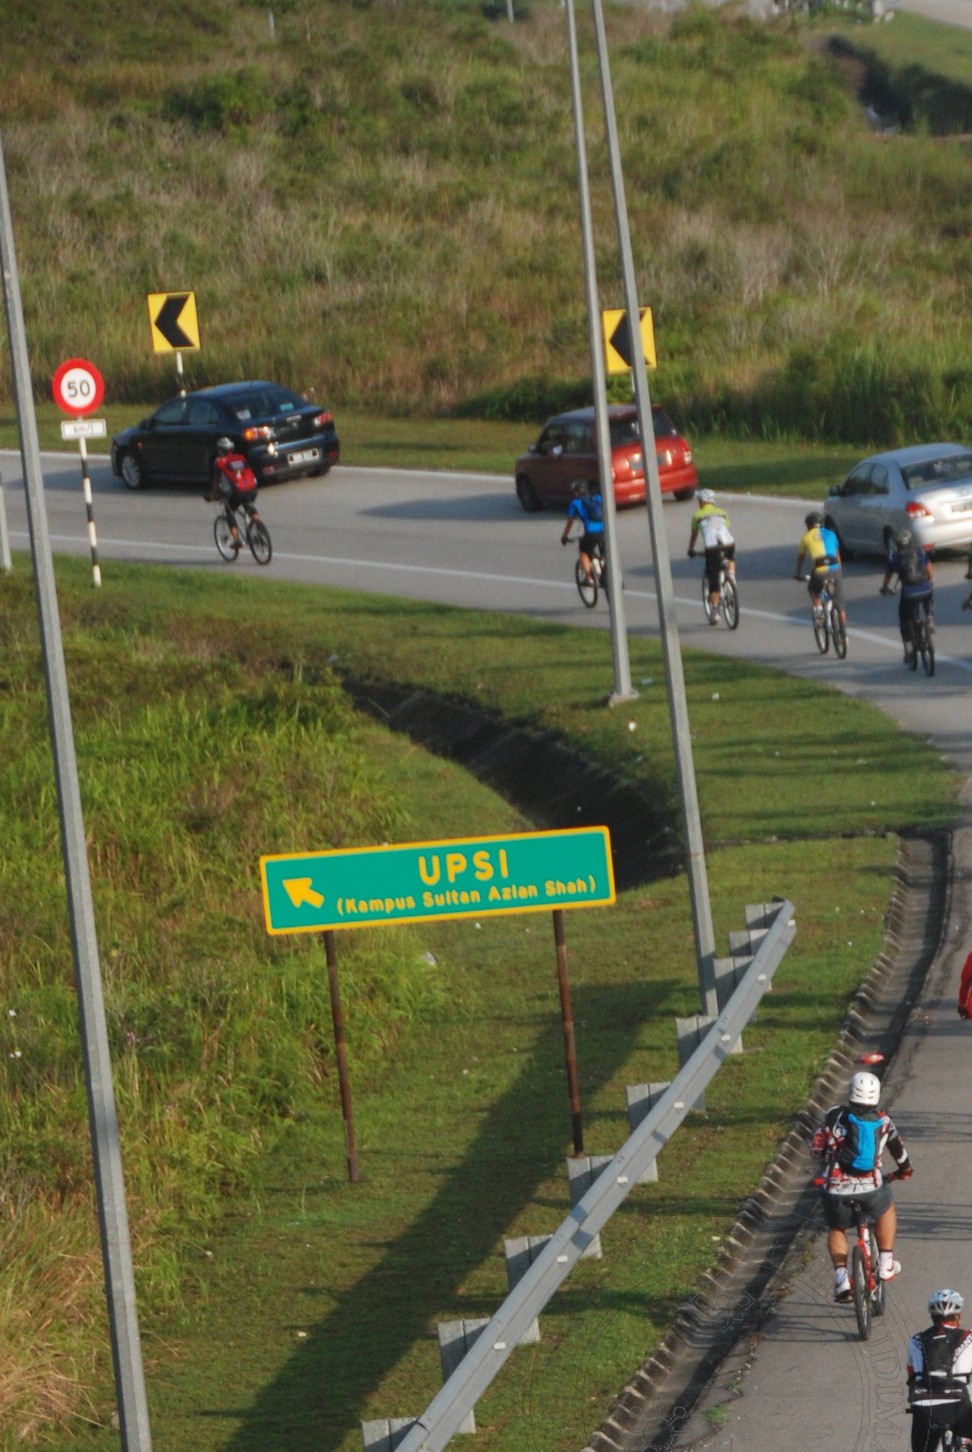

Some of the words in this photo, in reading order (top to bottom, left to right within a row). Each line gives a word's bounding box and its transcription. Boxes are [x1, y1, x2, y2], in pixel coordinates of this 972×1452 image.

[67, 380, 91, 398] 50
[418, 848, 509, 886] UPSI
[336, 896, 416, 917] (Kampus
[422, 889, 481, 908] Sultan
[488, 883, 539, 902] Azlan
[544, 874, 596, 897] Shah)
